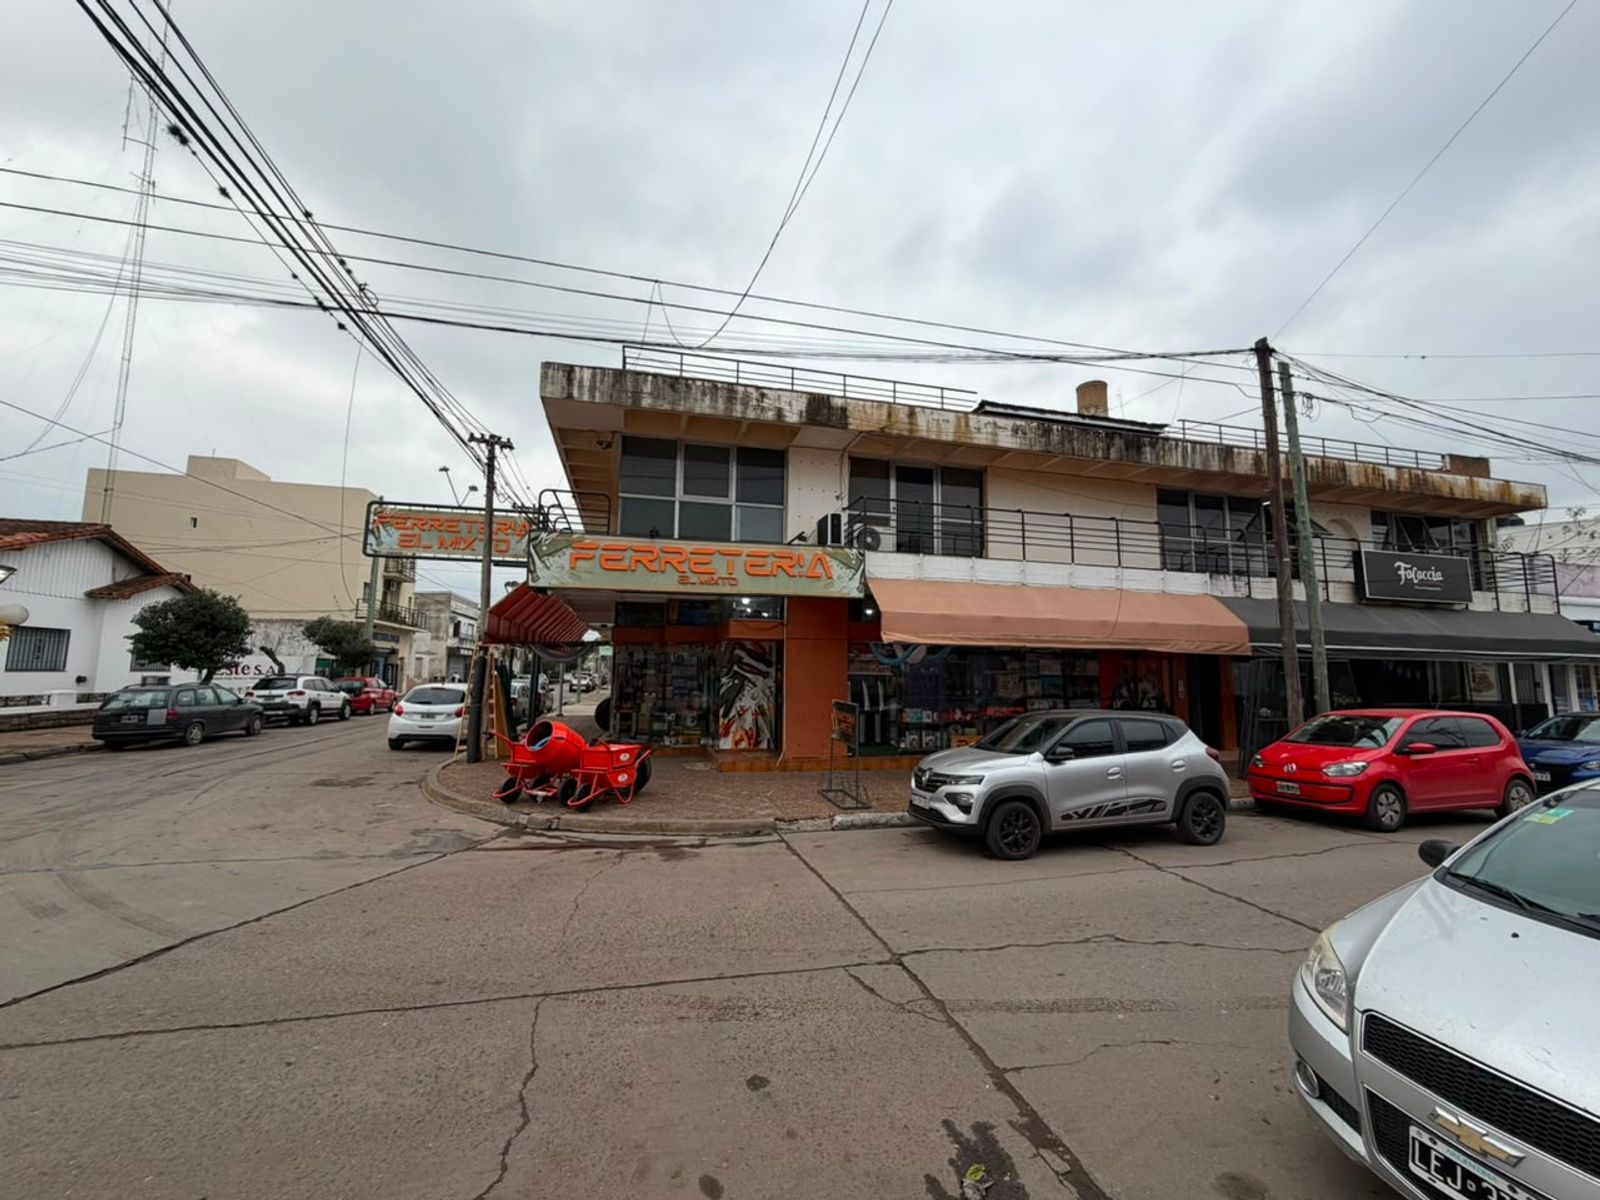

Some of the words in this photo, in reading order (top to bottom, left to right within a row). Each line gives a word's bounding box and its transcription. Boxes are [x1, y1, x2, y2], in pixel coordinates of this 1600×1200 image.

[399, 533, 433, 549] EL
[437, 535, 511, 554] MIXO
[569, 541, 833, 579] FERRETERIA
[1414, 1139, 1461, 1191] LEJ
